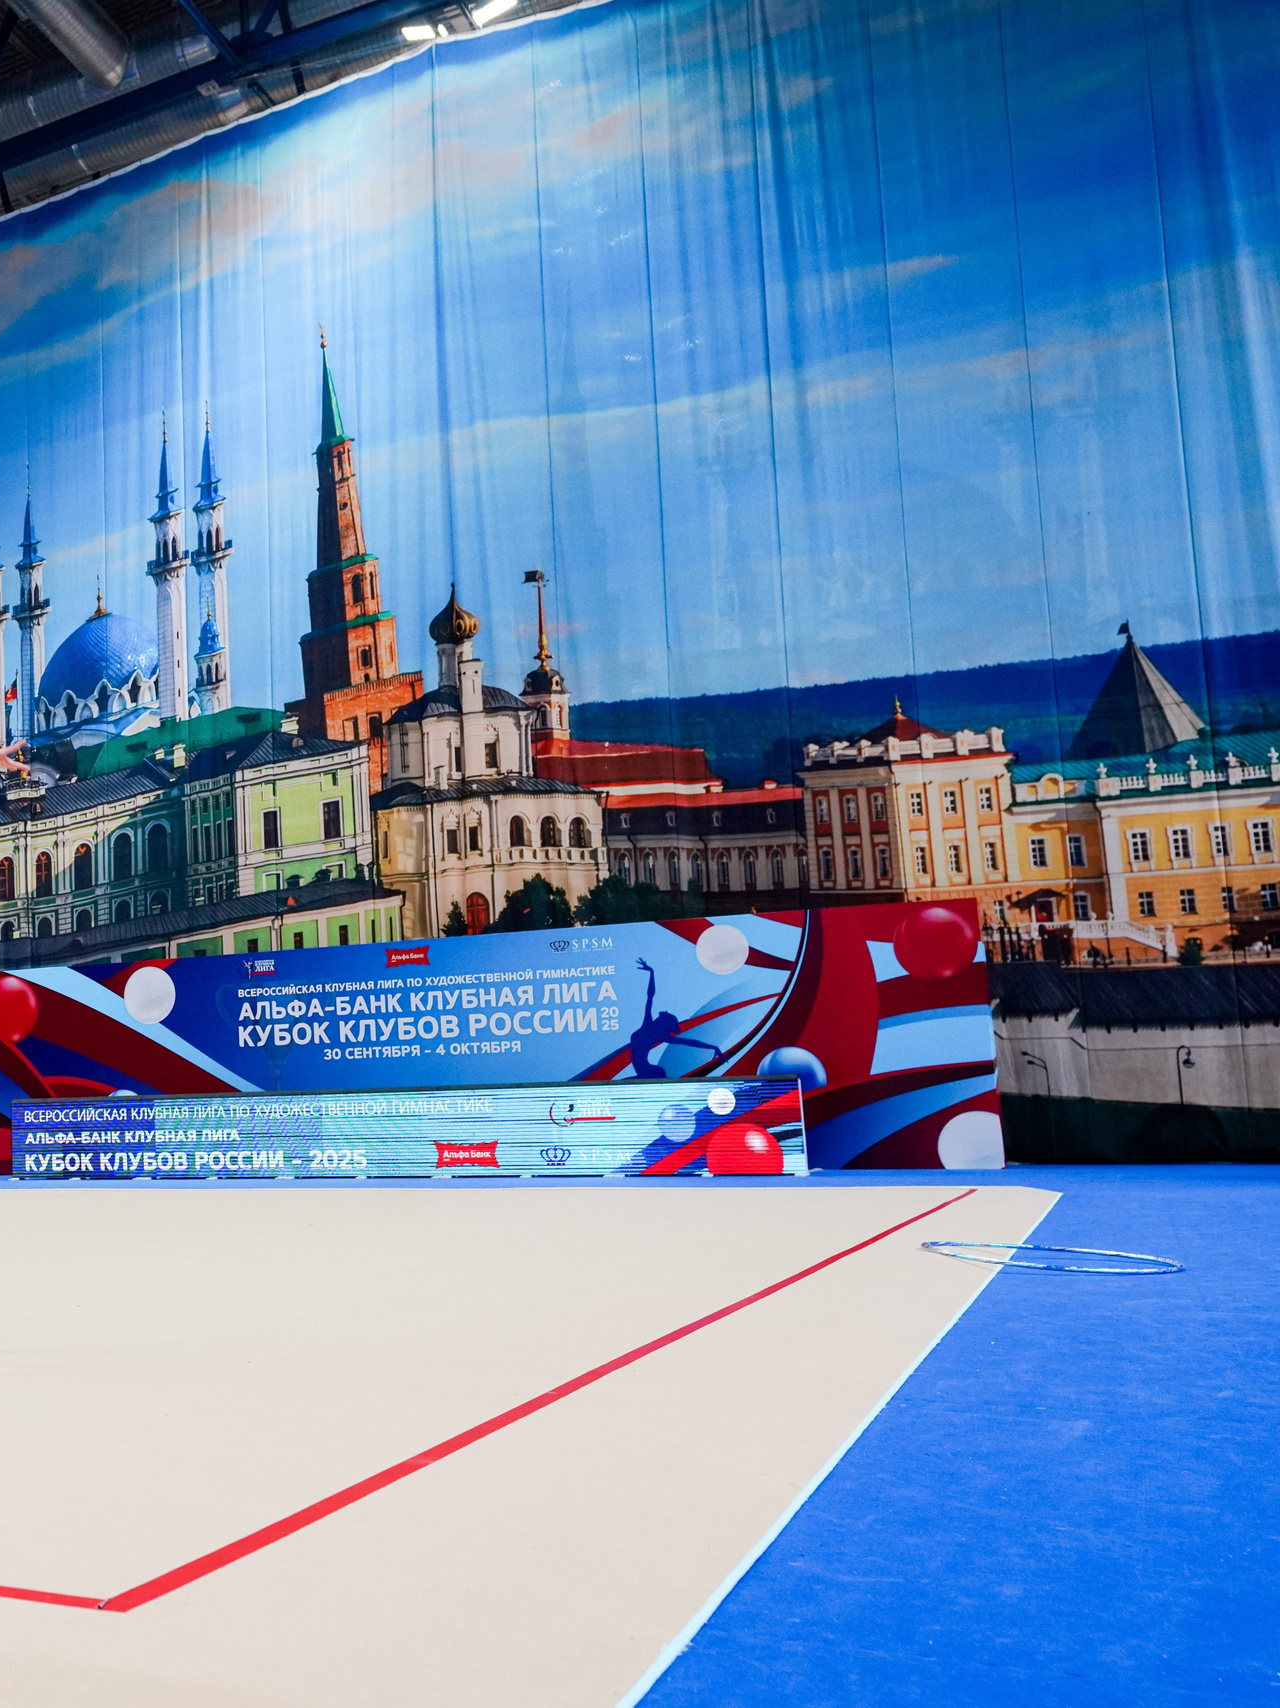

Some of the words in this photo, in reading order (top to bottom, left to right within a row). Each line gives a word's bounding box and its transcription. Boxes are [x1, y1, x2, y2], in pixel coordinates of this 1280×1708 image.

[238, 984, 323, 998] ВСЕРОССИЙСКАЯ
[325, 981, 374, 993] КЛУБНАЯ
[377, 979, 404, 990] ЛИГА
[407, 978, 422, 987] ПО
[425, 968, 533, 987] ХУДОЖЕСТВЕННОЙ
[536, 965, 616, 979] ГИМНАСТИКЕ
[239, 993, 403, 1021] АЛЬФА-БАНК
[410, 985, 534, 1012] КЛУБНАЯ
[542, 980, 618, 1005] ЛИГА
[600, 1006, 619, 1018] 20
[238, 1021, 331, 1047] КУБОК
[339, 1015, 460, 1043] КЛУБОВ
[468, 1007, 598, 1037] РОССИИ
[601, 1019, 619, 1031] 25
[323, 1048, 341, 1060] 30
[345, 1045, 421, 1059] СЕНТЯБРЯ
[435, 1044, 446, 1055] 4
[449, 1040, 521, 1055] ОКТЯБРЯ
[24, 1107, 127, 1123] ВСЕРОССИЙСКАЯ
[131, 1104, 189, 1120] КЛУБНАЯ
[192, 1105, 226, 1119] ЛИГА
[230, 1104, 250, 1118] ПО
[254, 1098, 387, 1119] ХУДОЖЕСТВЕННОЙ
[25, 1131, 121, 1144] АЛЬФА-БАНК
[125, 1129, 197, 1143] КЛУБНАЯ
[201, 1128, 241, 1141] ЛИГА
[25, 1152, 94, 1171] КУБОК
[100, 1151, 188, 1171] КЛУБОВ
[194, 1150, 285, 1170] РОССИИ
[309, 1149, 368, 1169] 2025
[443, 1150, 470, 1161] Альфа
[471, 1150, 492, 1158] Банк
